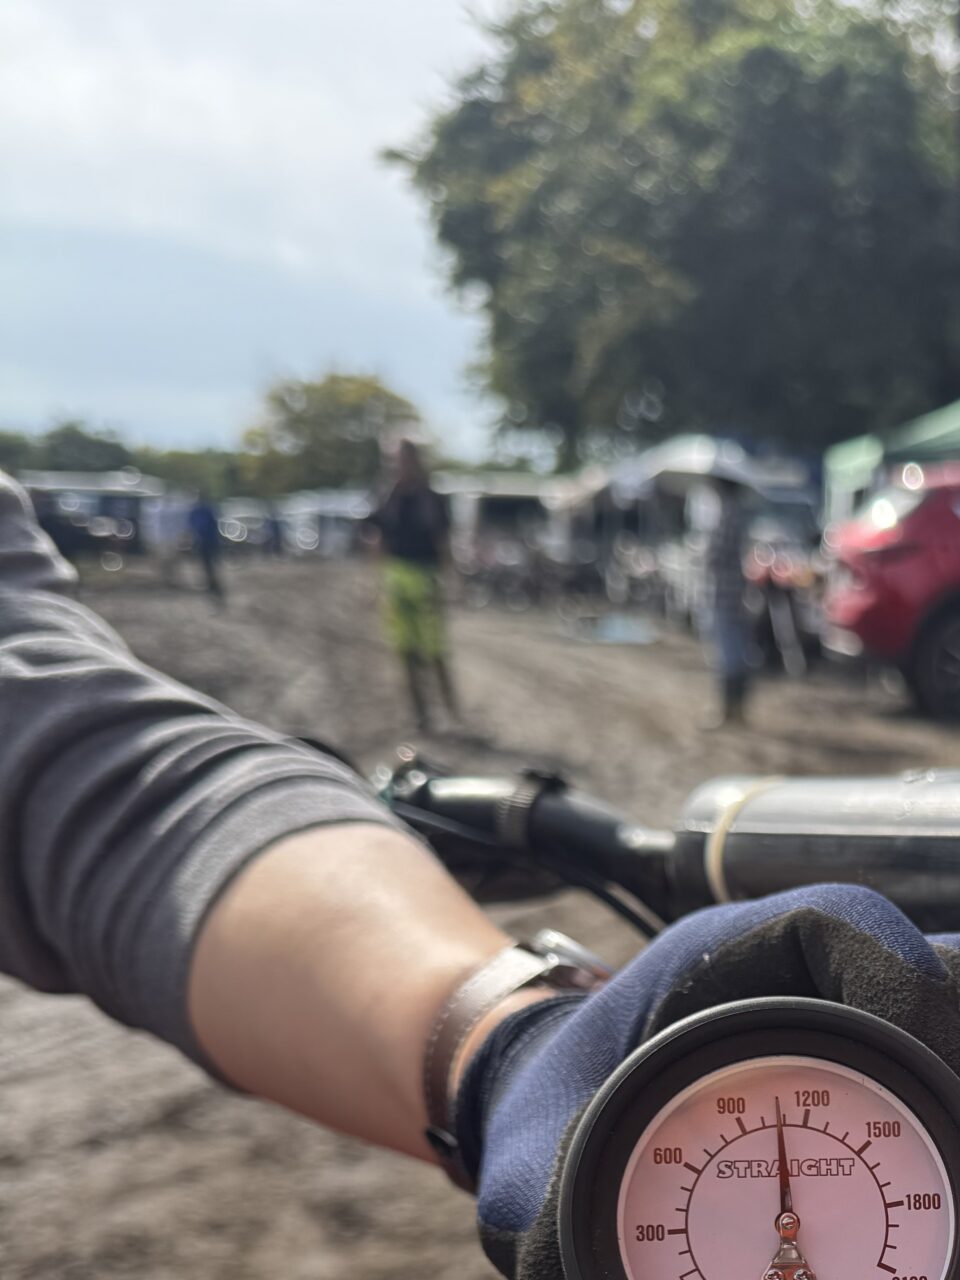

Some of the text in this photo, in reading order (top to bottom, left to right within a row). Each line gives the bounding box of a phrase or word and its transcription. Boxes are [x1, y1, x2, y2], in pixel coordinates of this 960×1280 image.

[717, 1098, 745, 1114] 900
[794, 1091, 830, 1107] 1200
[866, 1121, 901, 1138] 1500
[653, 1148, 682, 1164] 600
[717, 1157, 855, 1178] STRAIGHT
[906, 1194, 941, 1210] 1800
[636, 1225, 665, 1241] 300
